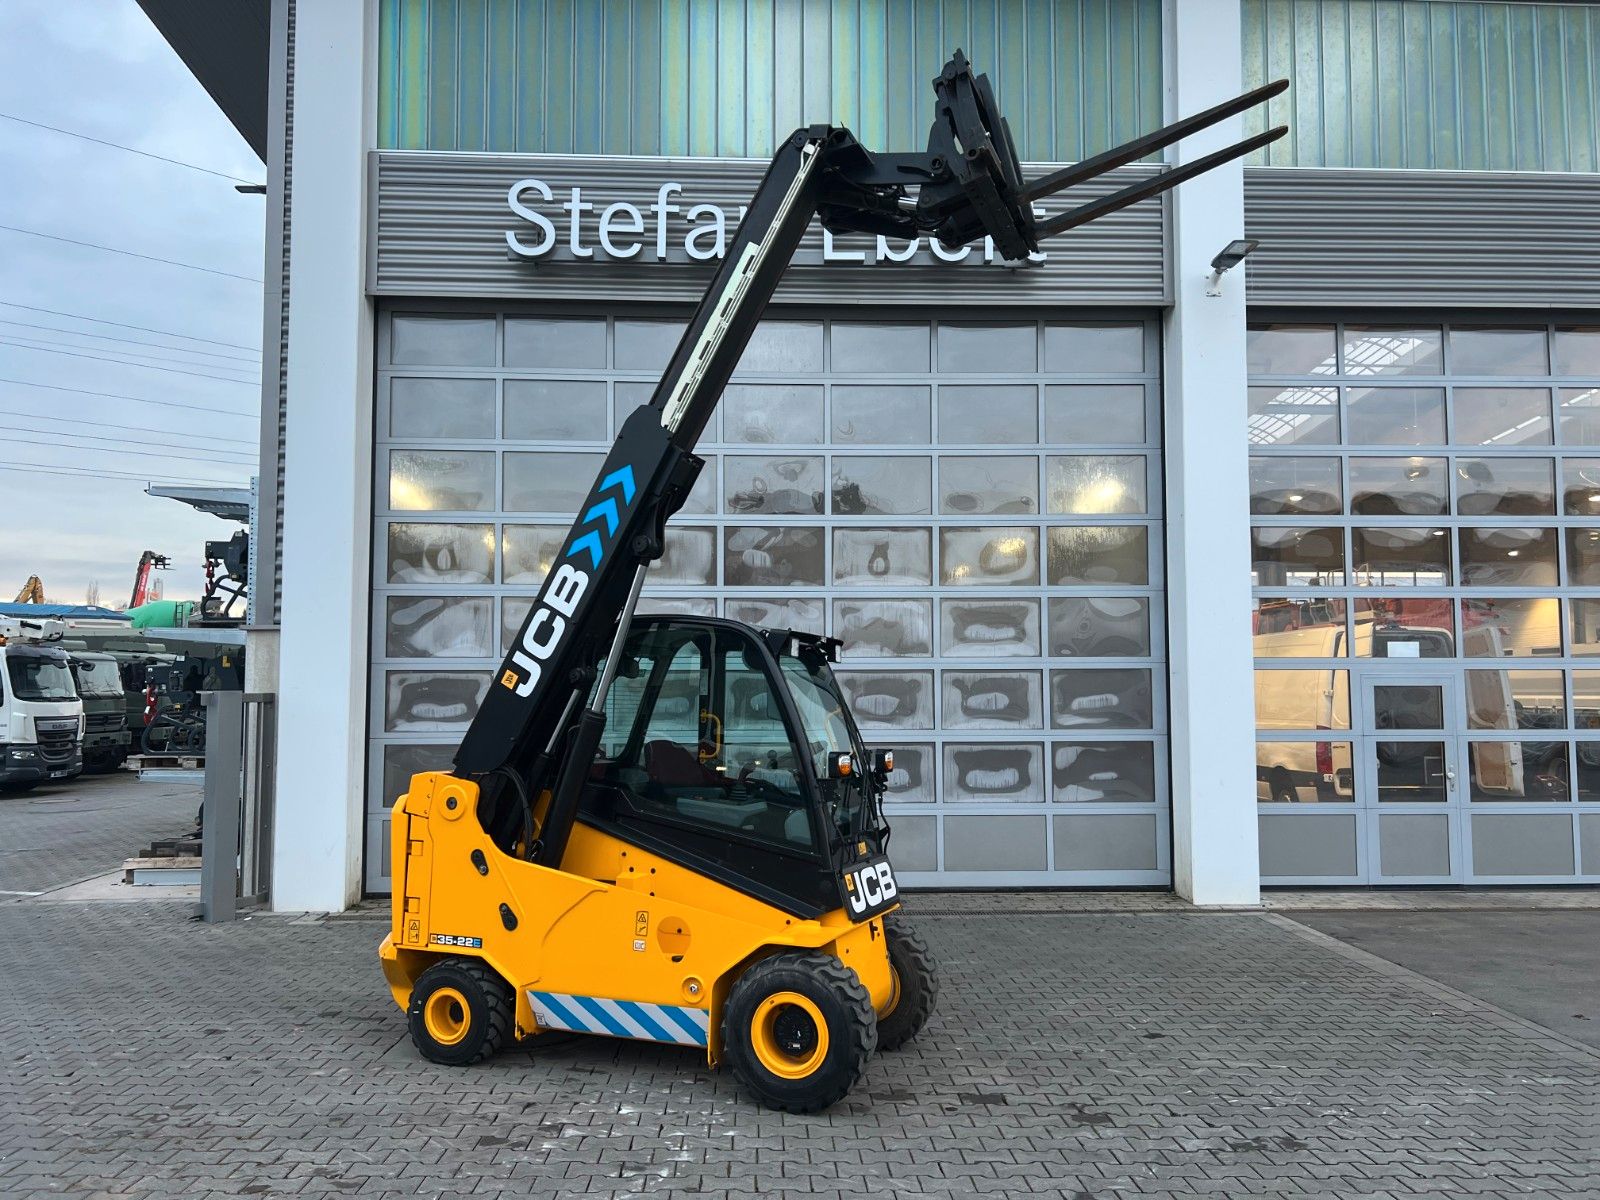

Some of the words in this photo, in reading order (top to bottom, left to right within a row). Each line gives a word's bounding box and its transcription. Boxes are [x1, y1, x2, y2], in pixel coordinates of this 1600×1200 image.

[505, 178, 748, 260] Stefa
[511, 563, 589, 698] JCB
[850, 861, 897, 914] JCB
